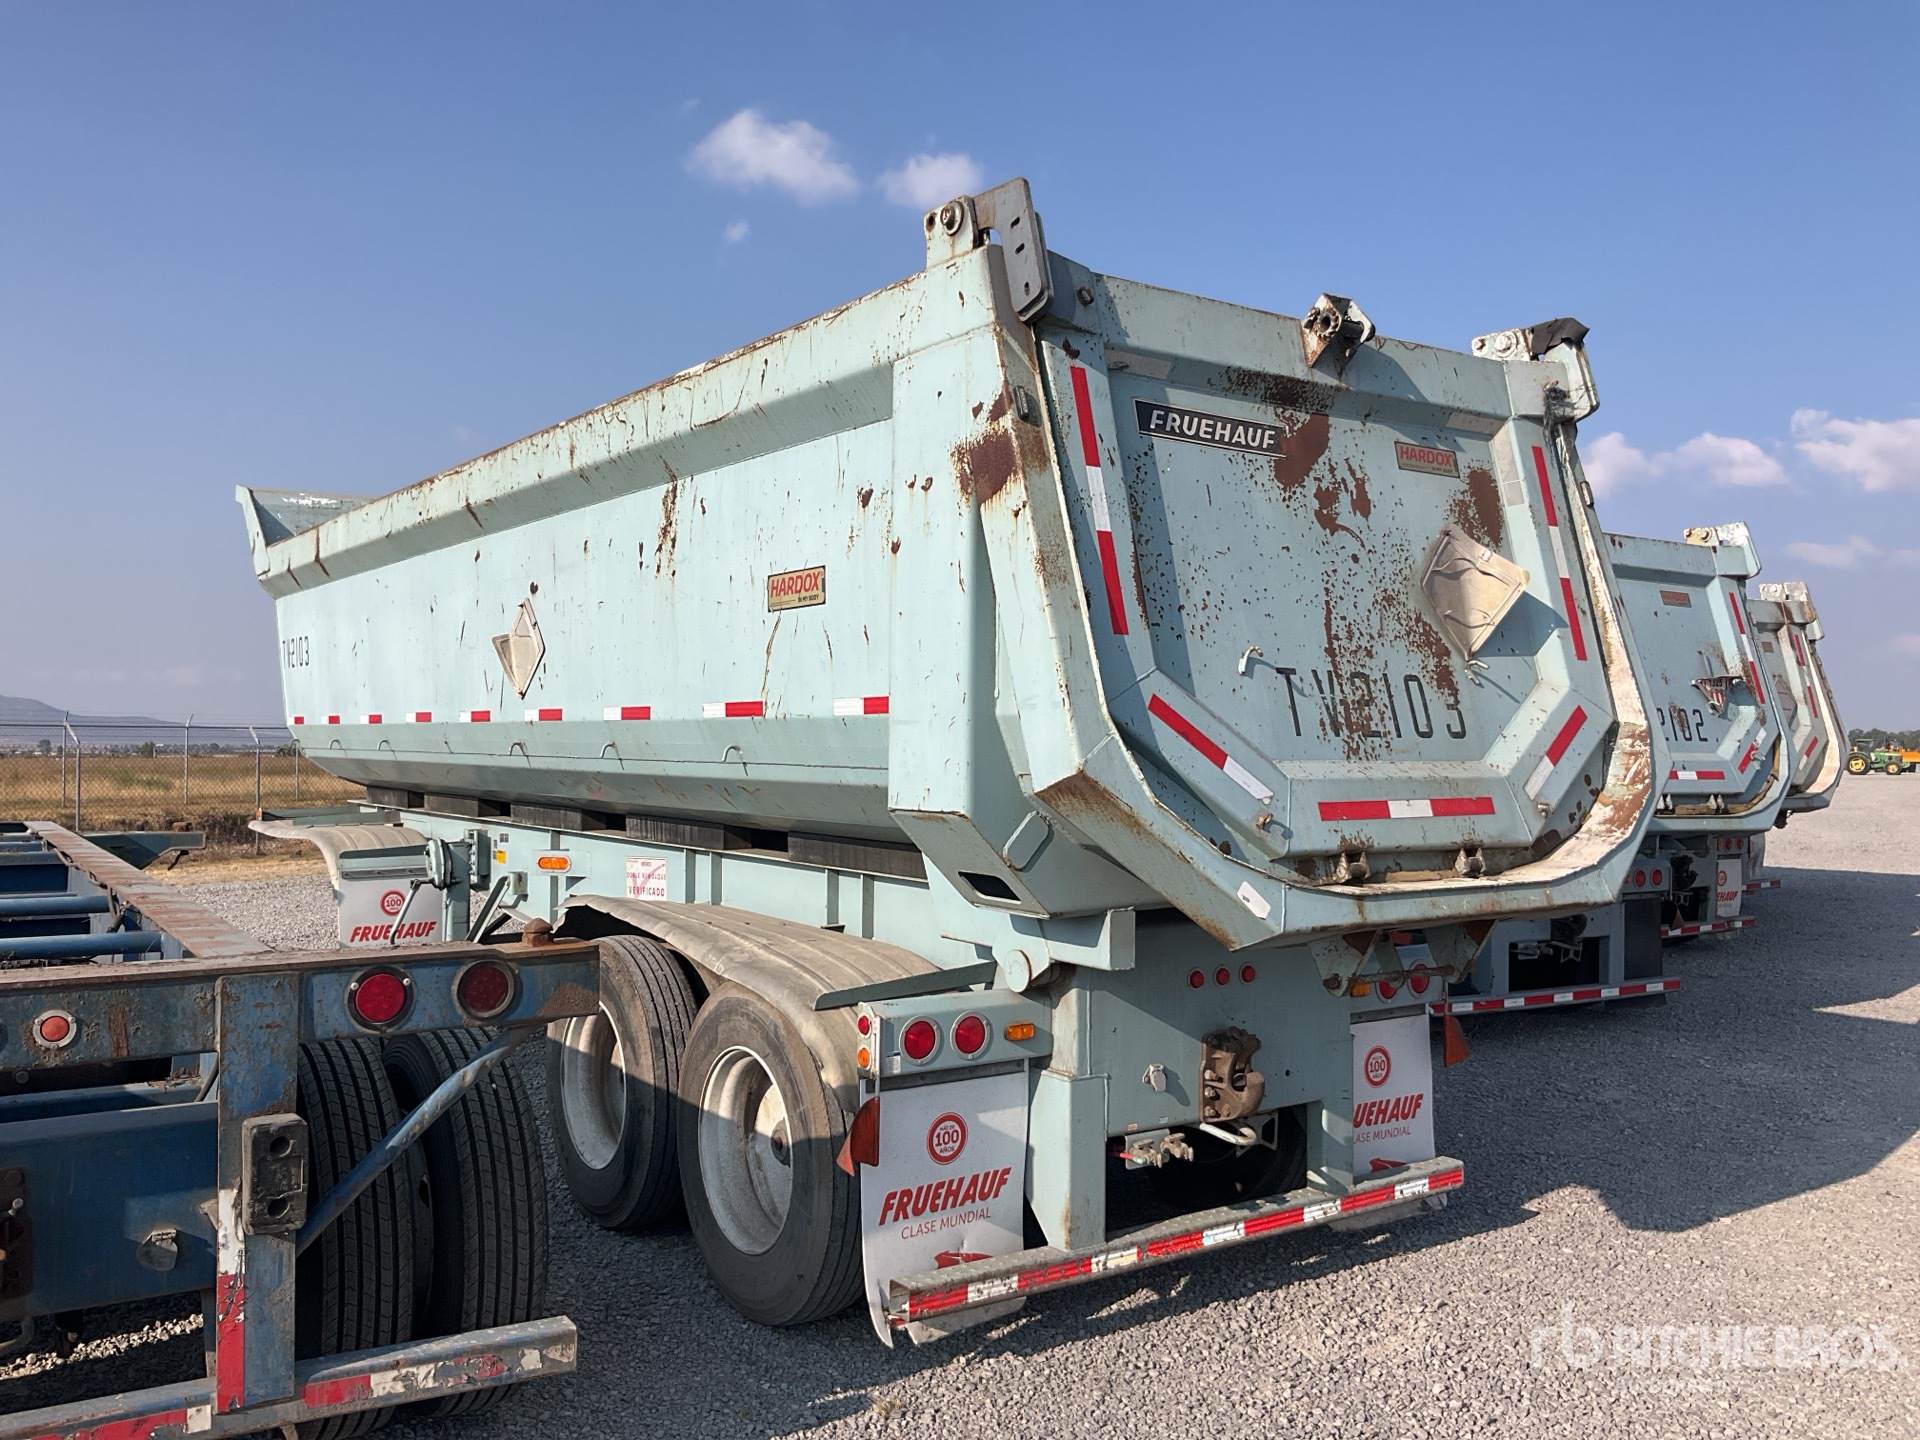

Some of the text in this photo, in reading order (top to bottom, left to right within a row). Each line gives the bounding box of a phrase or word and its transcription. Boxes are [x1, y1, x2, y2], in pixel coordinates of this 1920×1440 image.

[1150, 409, 1276, 449] FRUEHAUF
[1400, 445, 1453, 468] HARDOX
[770, 571, 820, 598] HARDOX
[628, 886, 665, 897] VERIFICADO
[386, 899, 401, 907] 100
[350, 921, 437, 943] FRUEHAUF
[1369, 1060, 1386, 1073] 100
[1353, 1093, 1424, 1128] UEHAUF
[935, 1129, 959, 1147] 100
[1354, 1126, 1411, 1144] ASE MUNDIAL
[879, 1167, 1012, 1226] FRUEHAUF
[901, 1208, 991, 1240] CLASE MUNDIAL
